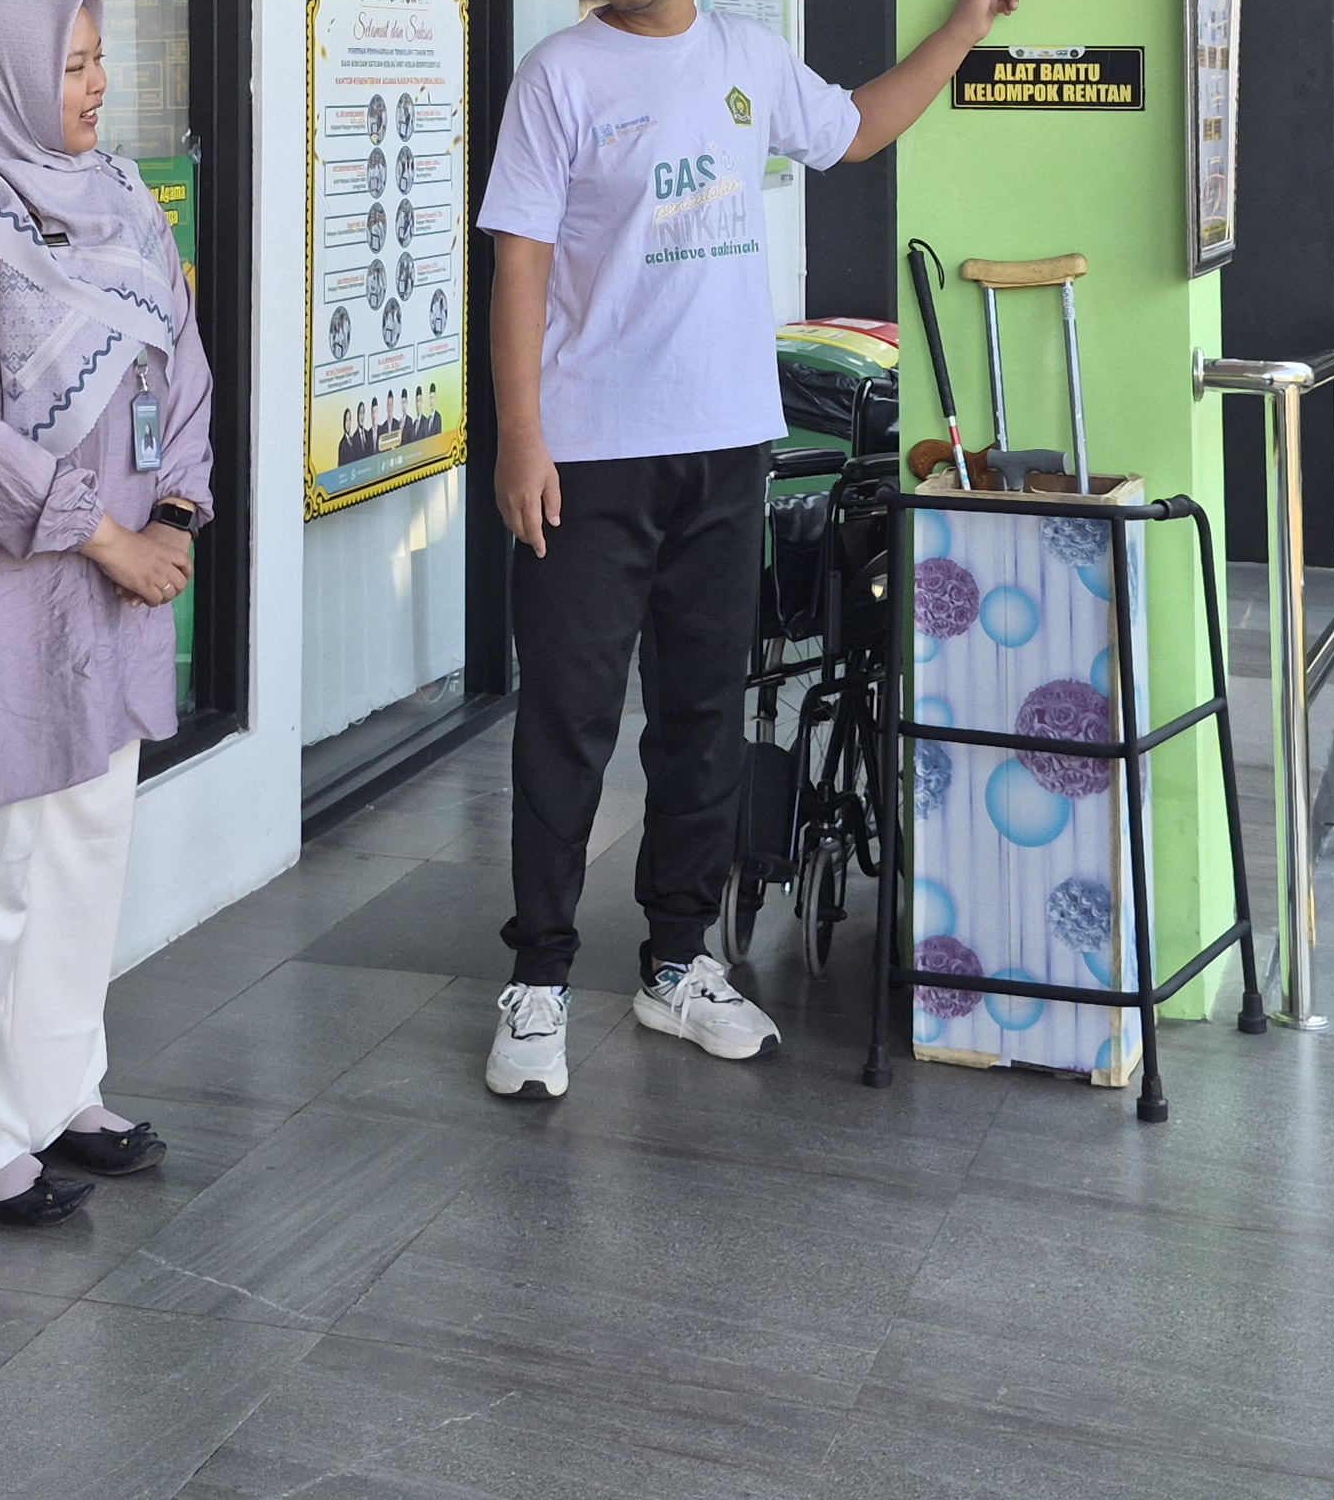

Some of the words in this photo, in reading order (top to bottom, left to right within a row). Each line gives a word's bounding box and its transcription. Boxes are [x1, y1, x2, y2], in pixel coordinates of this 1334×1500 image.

[353, 11, 390, 41] Selamat
[390, 19, 404, 39] dan
[405, 14, 433, 43] Sukses
[993, 62, 1037, 82] ALAT
[1040, 62, 1101, 82] BANTU
[964, 83, 1060, 102] KELOMPOK
[1062, 83, 1133, 103] RENTAN
[653, 154, 716, 200] GAS
[159, 184, 187, 204] Agama
[652, 178, 744, 232] pencatatan
[657, 190, 747, 246] NIKAH
[644, 247, 706, 265] achieve
[710, 239, 759, 258] sakinah
